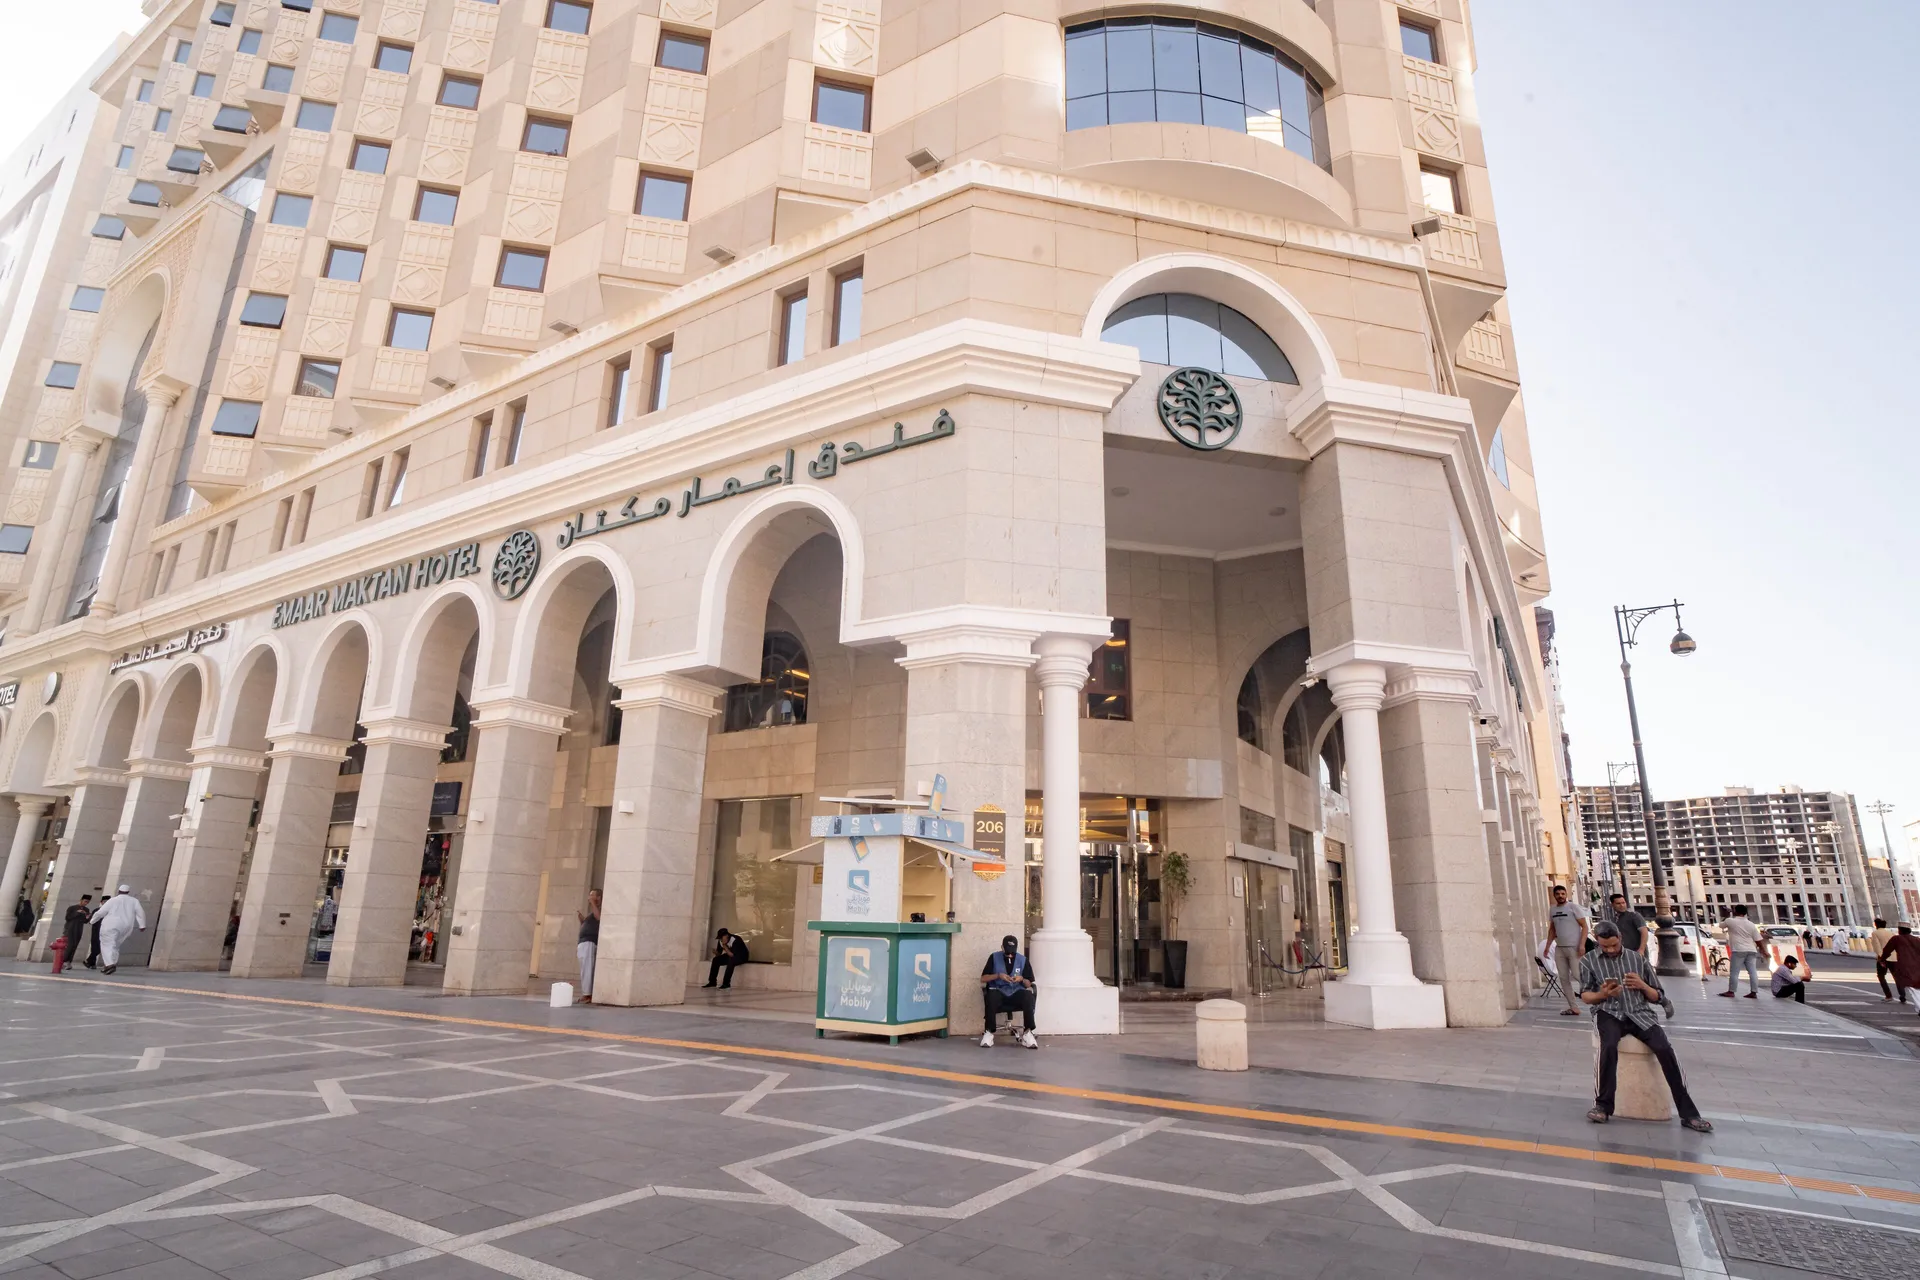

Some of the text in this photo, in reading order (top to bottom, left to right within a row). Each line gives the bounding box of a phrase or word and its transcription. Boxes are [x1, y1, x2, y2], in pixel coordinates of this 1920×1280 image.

[556, 408, 956, 550] فندق إعمار مكتان
[271, 542, 481, 630] EMAAR MAKTAN HOTEL
[187, 622, 226, 653] فندق
[976, 820, 1004, 834] 206
[840, 995, 871, 1011] Mobily
[913, 993, 931, 1003] Mobily
